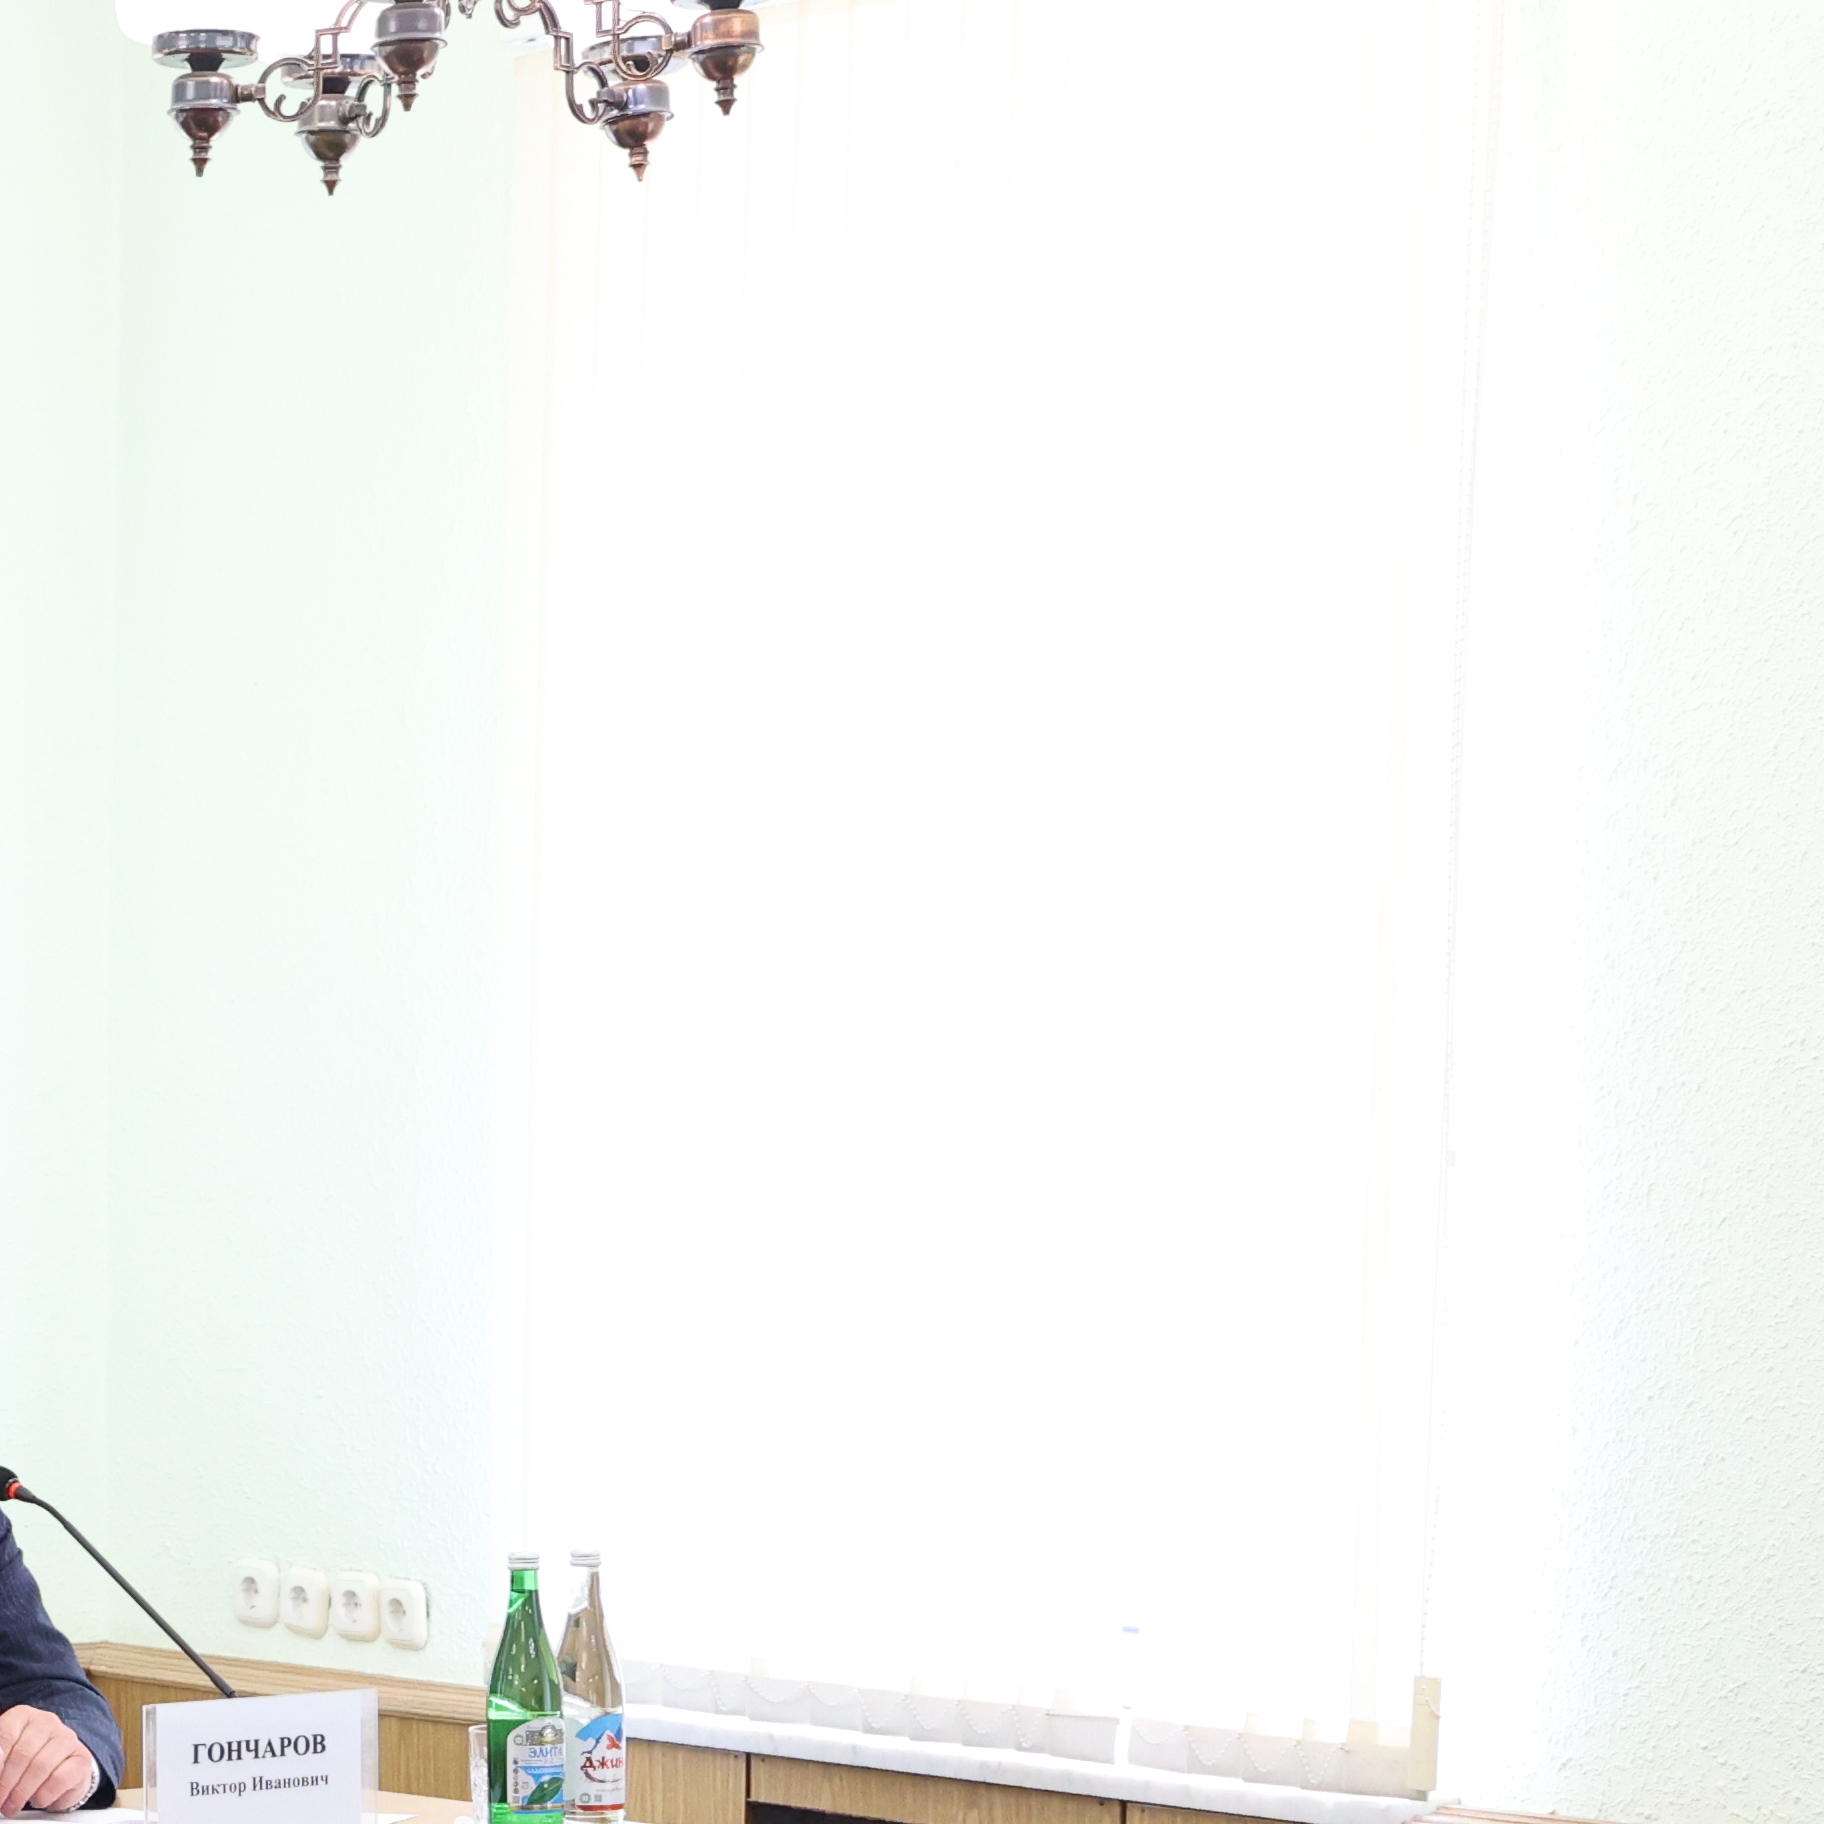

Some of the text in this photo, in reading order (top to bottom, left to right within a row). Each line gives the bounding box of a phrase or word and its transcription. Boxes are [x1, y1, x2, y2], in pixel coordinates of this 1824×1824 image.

[192, 1733, 327, 1765] ГОНЧАРОВ
[189, 1774, 329, 1797] Виктор Иванович
